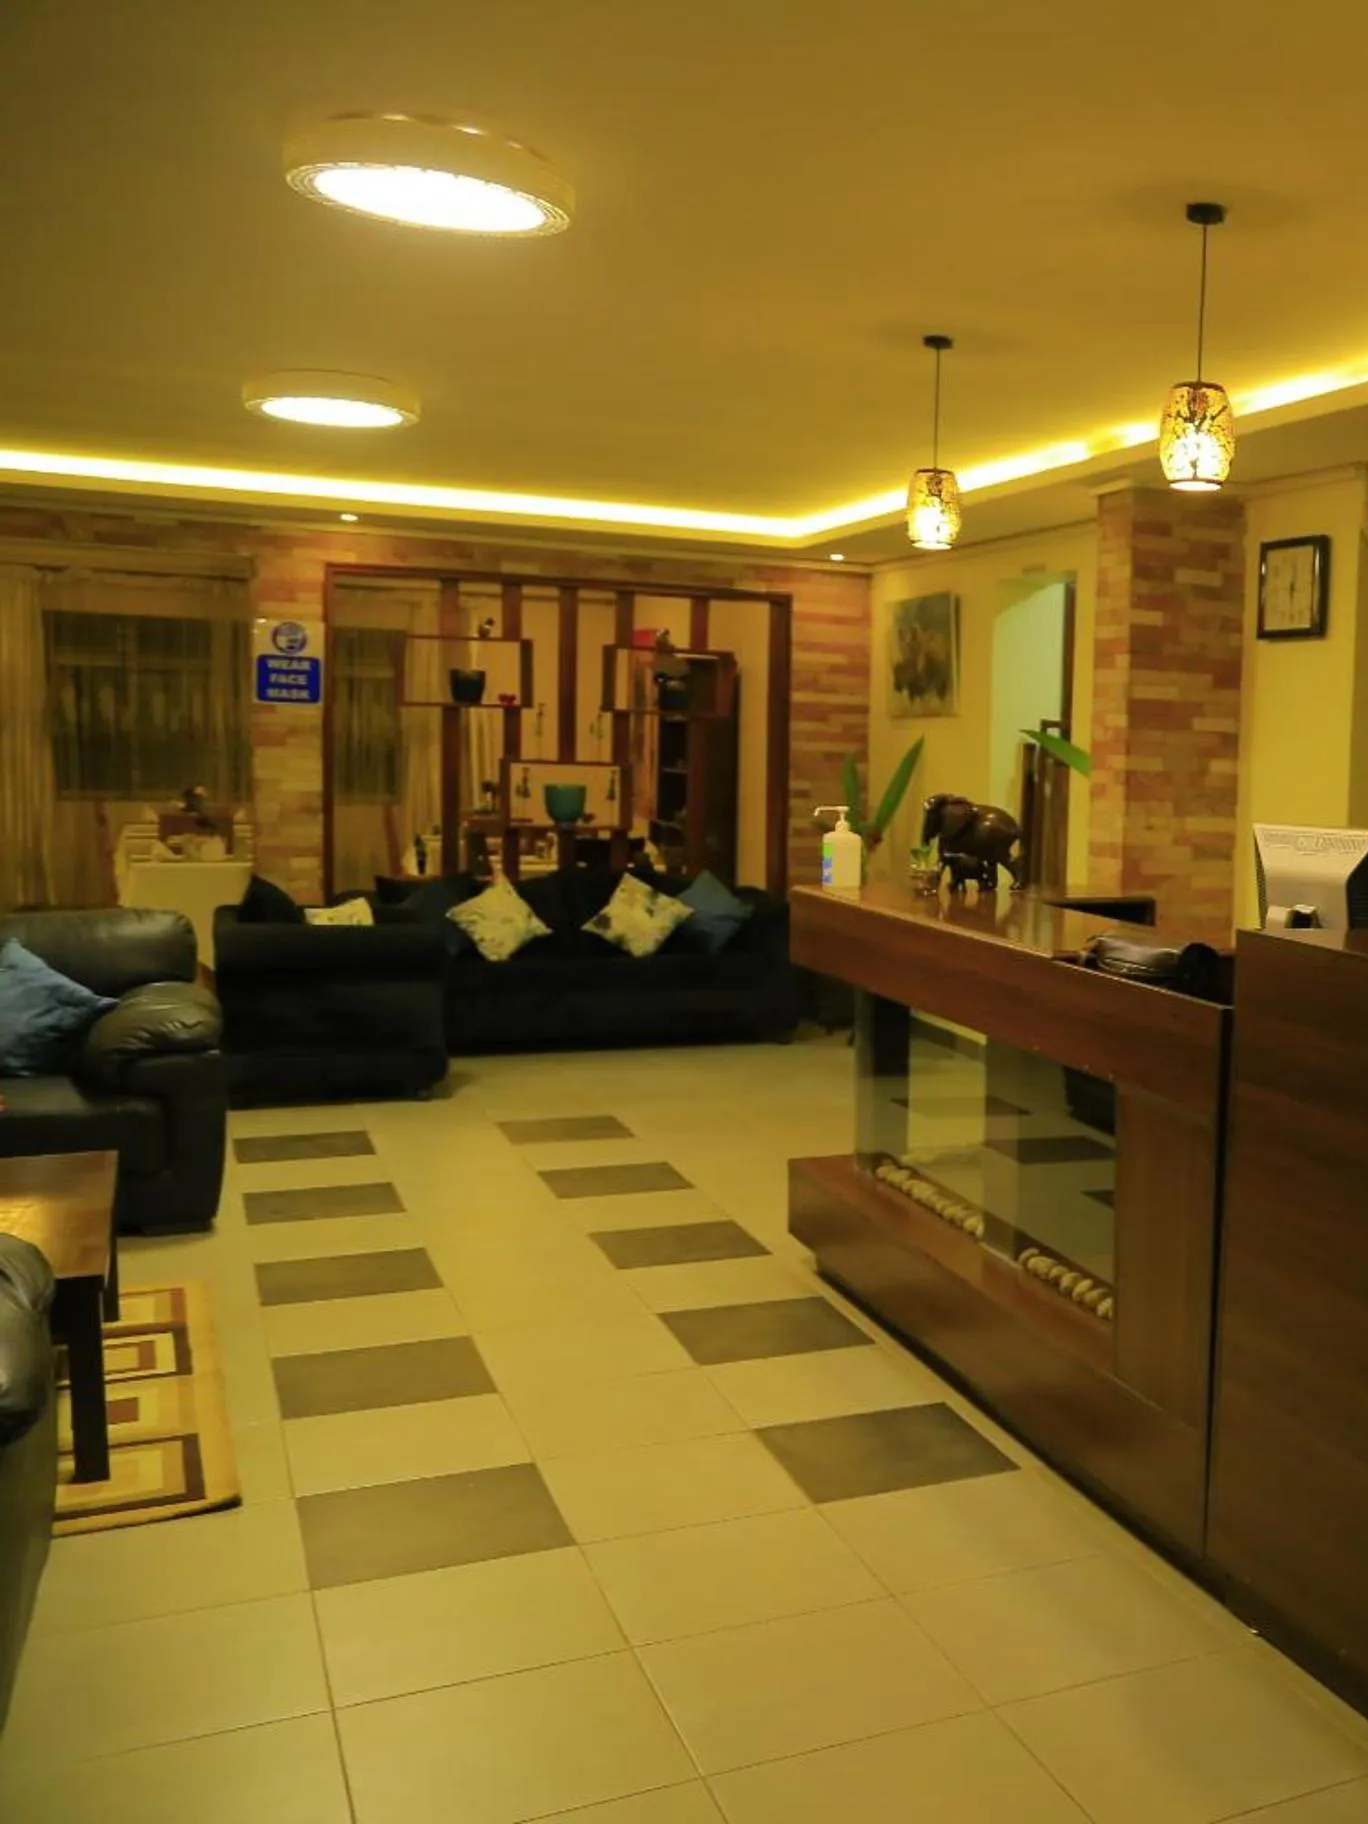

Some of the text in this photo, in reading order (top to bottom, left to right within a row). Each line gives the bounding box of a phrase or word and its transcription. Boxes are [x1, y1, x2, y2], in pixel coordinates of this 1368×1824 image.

[267, 659, 311, 671] WEAR
[270, 673, 307, 685] FACE
[266, 687, 310, 699] MASK
